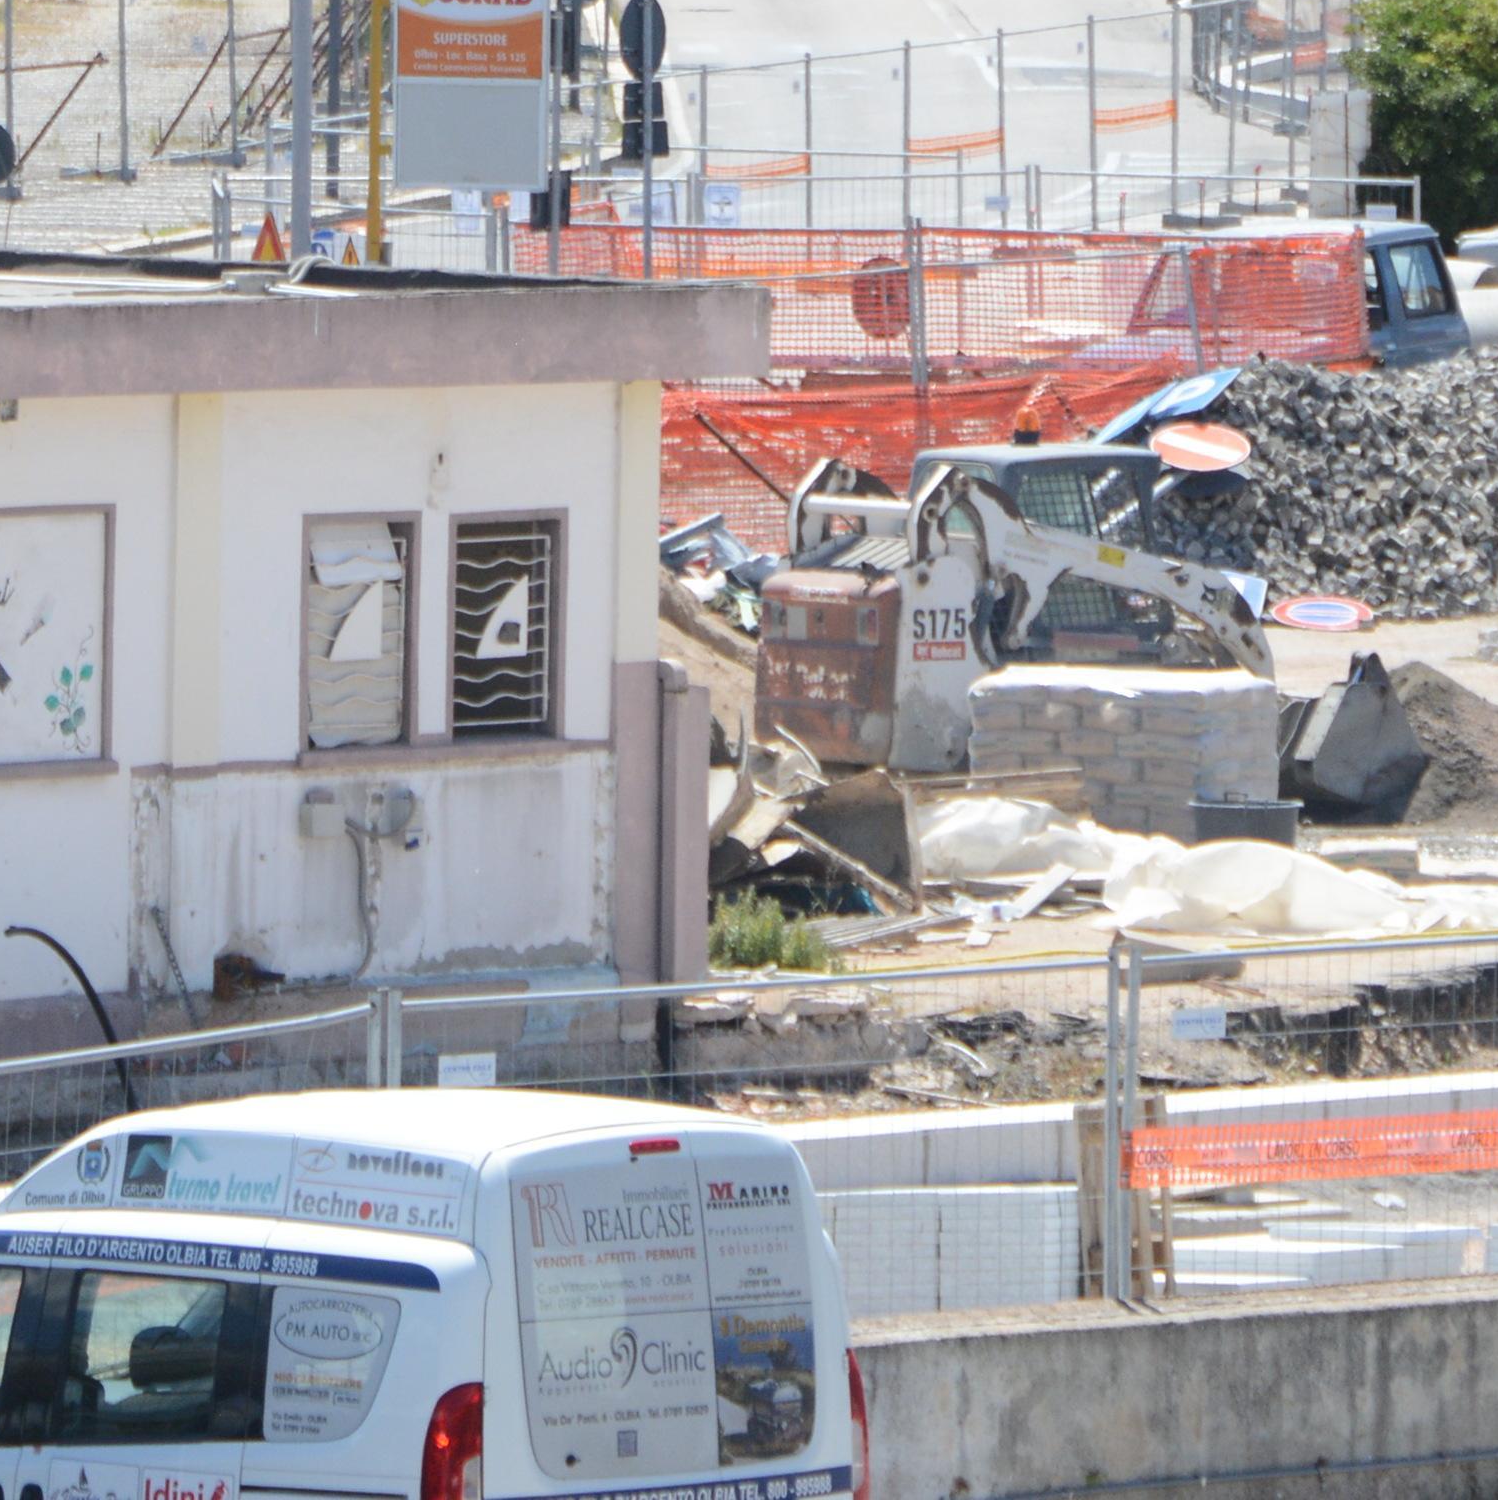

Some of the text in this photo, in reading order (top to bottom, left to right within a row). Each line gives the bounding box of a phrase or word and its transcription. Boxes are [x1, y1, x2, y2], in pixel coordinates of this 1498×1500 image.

[433, 31, 508, 47] SUPERSTORE
[912, 608, 966, 640] S175
[1136, 1149, 1174, 1167] CORSO
[25, 1189, 106, 1206] Comune di Olbia
[121, 1183, 165, 1198] GRUPPO
[227, 1173, 282, 1204] travel
[706, 1181, 790, 1201] MARINO
[293, 1188, 399, 1224] technova
[406, 1203, 455, 1230] s.r.l.
[582, 1203, 695, 1245] REALCASE
[8, 1235, 52, 1255] AUSER
[54, 1238, 85, 1257] FILO
[85, 1238, 164, 1263] D'ARGENTO
[166, 1243, 207, 1266] OLBIA
[534, 1250, 586, 1269] VENDITE
[595, 1248, 637, 1265] AFFITTI
[645, 1246, 697, 1262] PERMUTE
[310, 1323, 350, 1341] AUTO
[538, 1345, 613, 1383] Audio
[641, 1340, 706, 1376] Clinic
